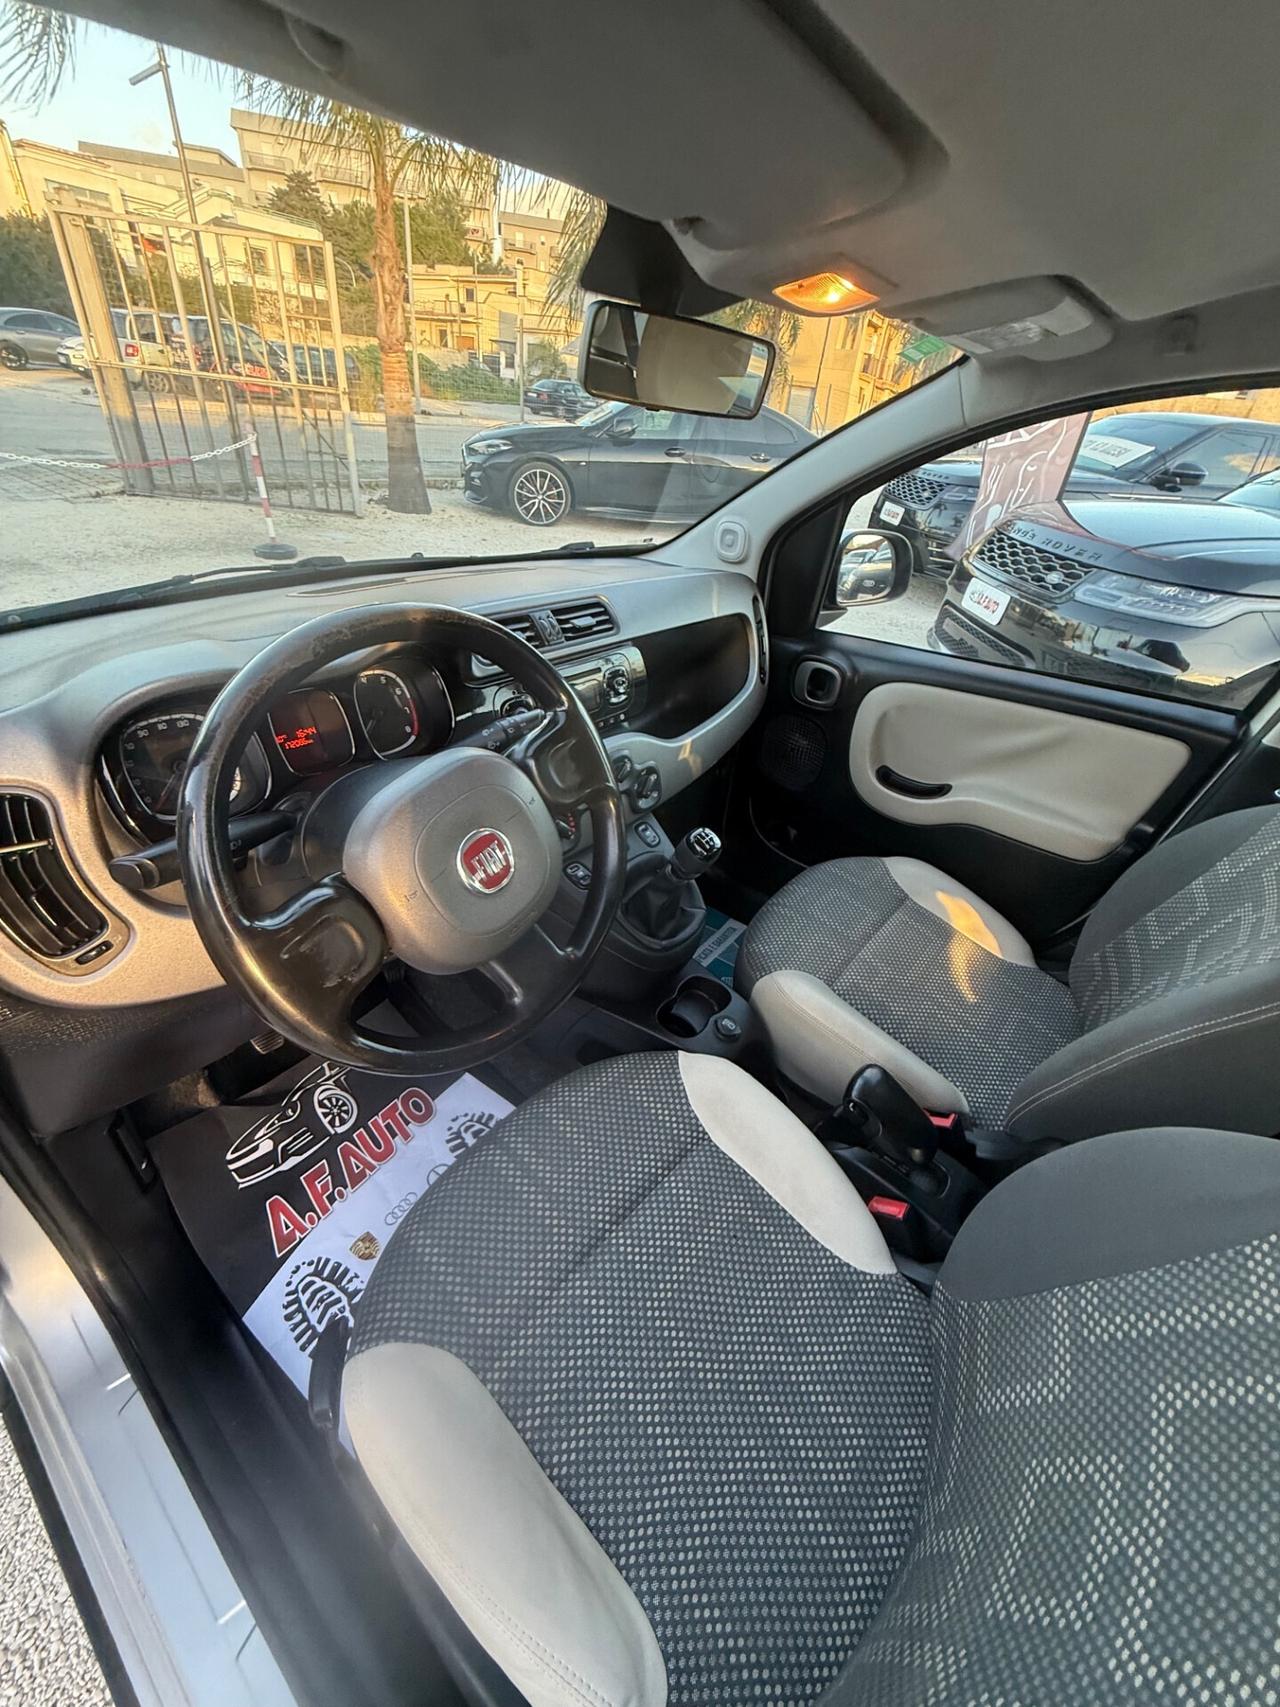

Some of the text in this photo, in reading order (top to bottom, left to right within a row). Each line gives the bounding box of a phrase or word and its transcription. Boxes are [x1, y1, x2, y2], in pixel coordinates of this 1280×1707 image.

[1041, 537, 1104, 562] ROVER
[470, 840, 508, 881] FIAT
[265, 1086, 436, 1259] A.F.AUTO
